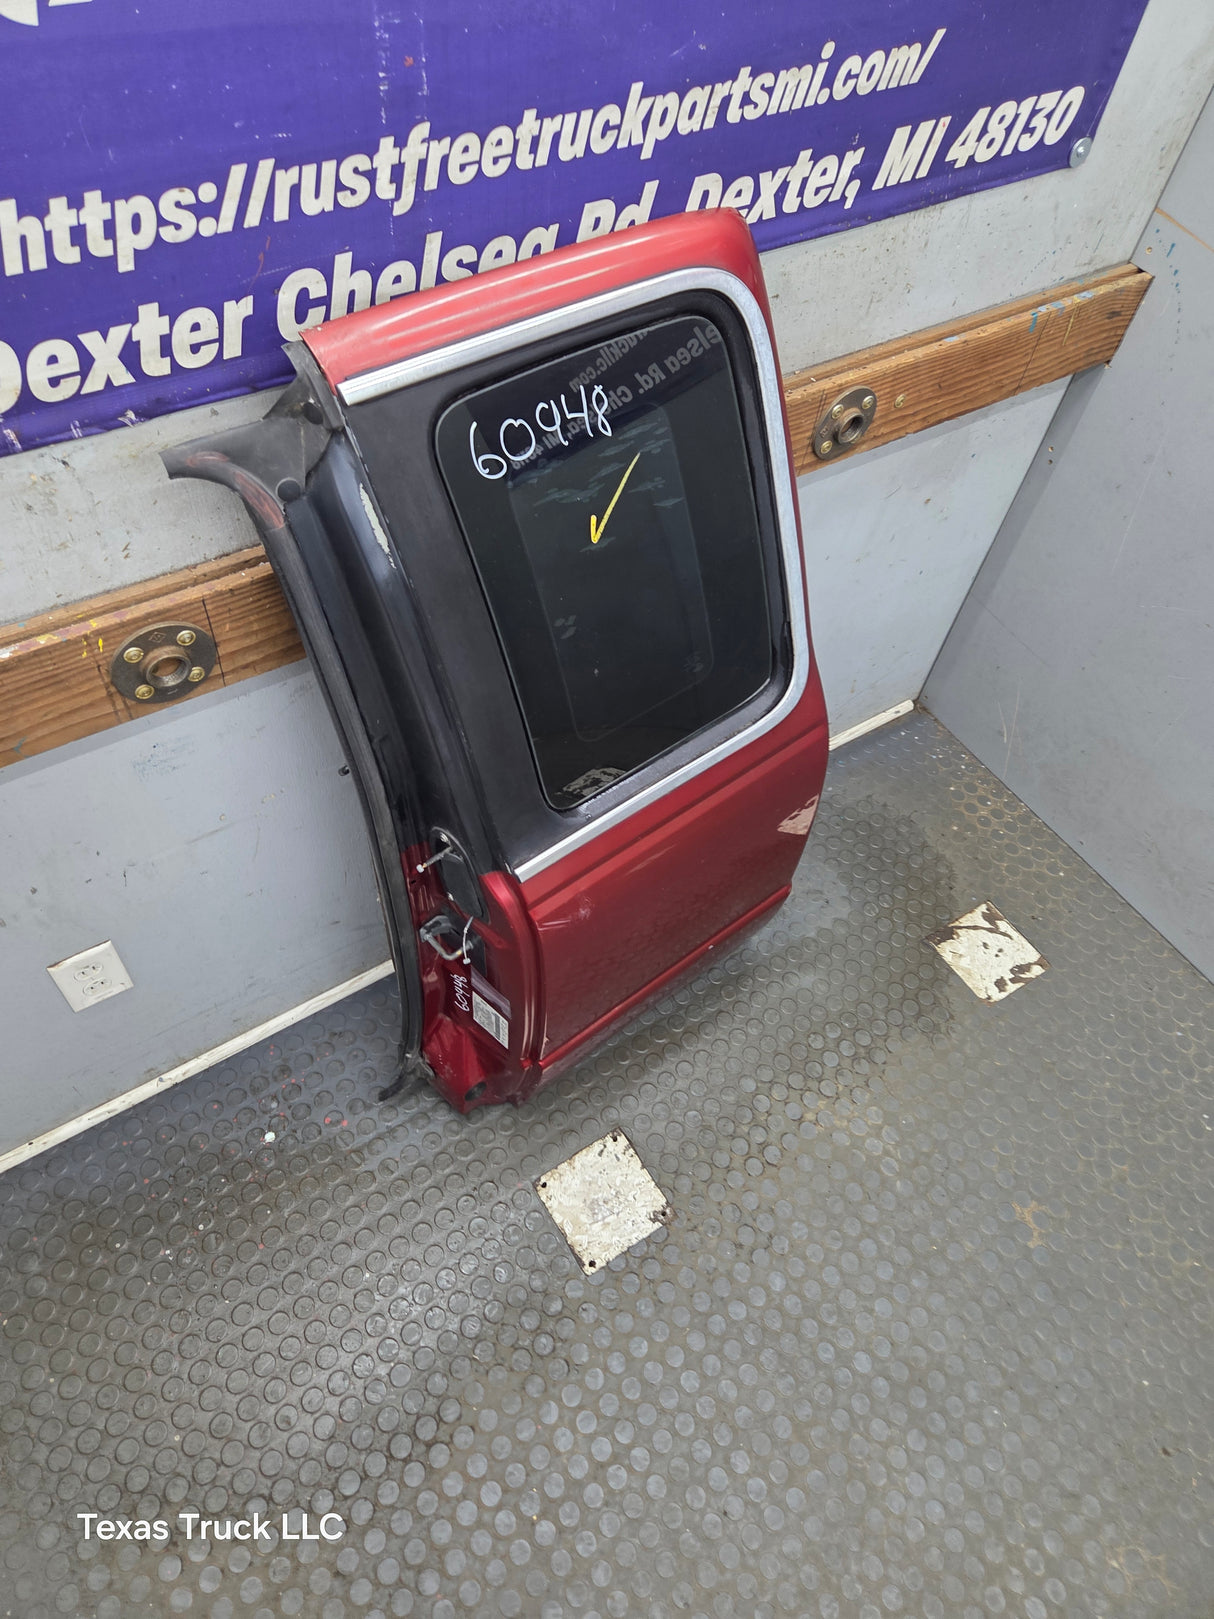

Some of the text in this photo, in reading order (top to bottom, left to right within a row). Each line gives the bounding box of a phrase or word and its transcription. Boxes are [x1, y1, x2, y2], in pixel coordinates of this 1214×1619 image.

[0, 28, 947, 276] https://rustfreetruckpartsmi.com/
[872, 116, 953, 190] MI
[946, 86, 1086, 169] 48130
[469, 384, 613, 480] 60948
[450, 973, 470, 1012] 60948
